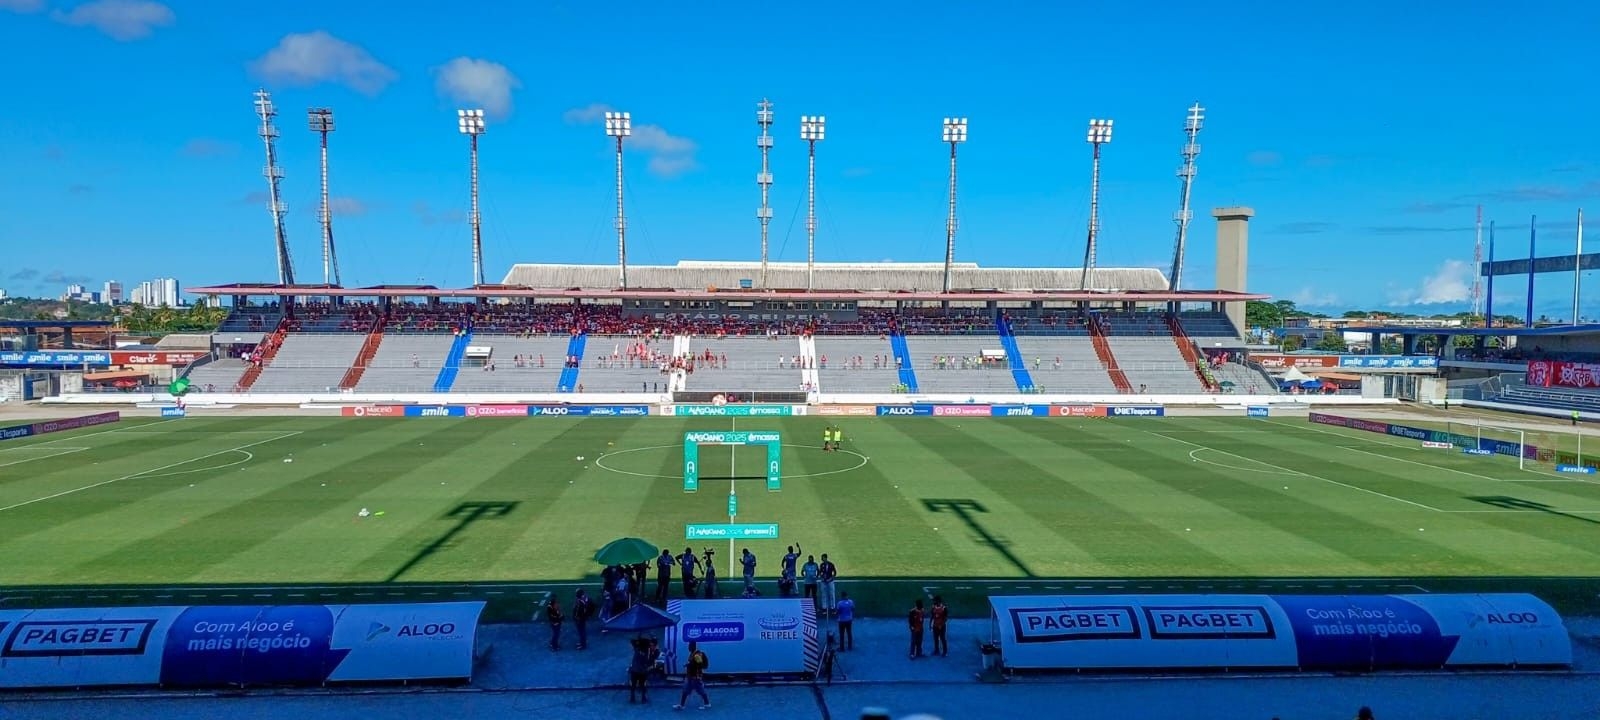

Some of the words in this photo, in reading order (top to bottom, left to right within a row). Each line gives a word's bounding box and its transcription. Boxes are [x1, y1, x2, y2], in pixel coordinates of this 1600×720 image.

[1, 353, 24, 361] smile
[56, 353, 79, 361] smile
[83, 353, 106, 362] smile
[1344, 358, 1362, 366] smile
[1368, 358, 1388, 366] smile
[1418, 358, 1436, 366] smile
[162, 408, 184, 416] smile
[421, 408, 449, 416] smile
[541, 407, 568, 415] ALOO
[889, 407, 914, 415] ALOO
[1007, 407, 1033, 416] smile
[1248, 408, 1268, 416] smile
[1306, 609, 1346, 620] Com
[1384, 607, 1396, 618] é
[1027, 613, 1121, 631] PAGBET
[1160, 613, 1254, 629] PAGBET
[1487, 612, 1538, 625] ALOO
[193, 621, 236, 633] Com
[237, 620, 279, 633] Aloo
[282, 618, 294, 631] é
[397, 623, 455, 637] ALOO
[1314, 623, 1355, 636] mais
[1357, 620, 1422, 638] negócio
[23, 627, 135, 645] PAGBET
[760, 631, 775, 640] REI
[187, 637, 232, 652] mais
[235, 633, 311, 653] negócio
